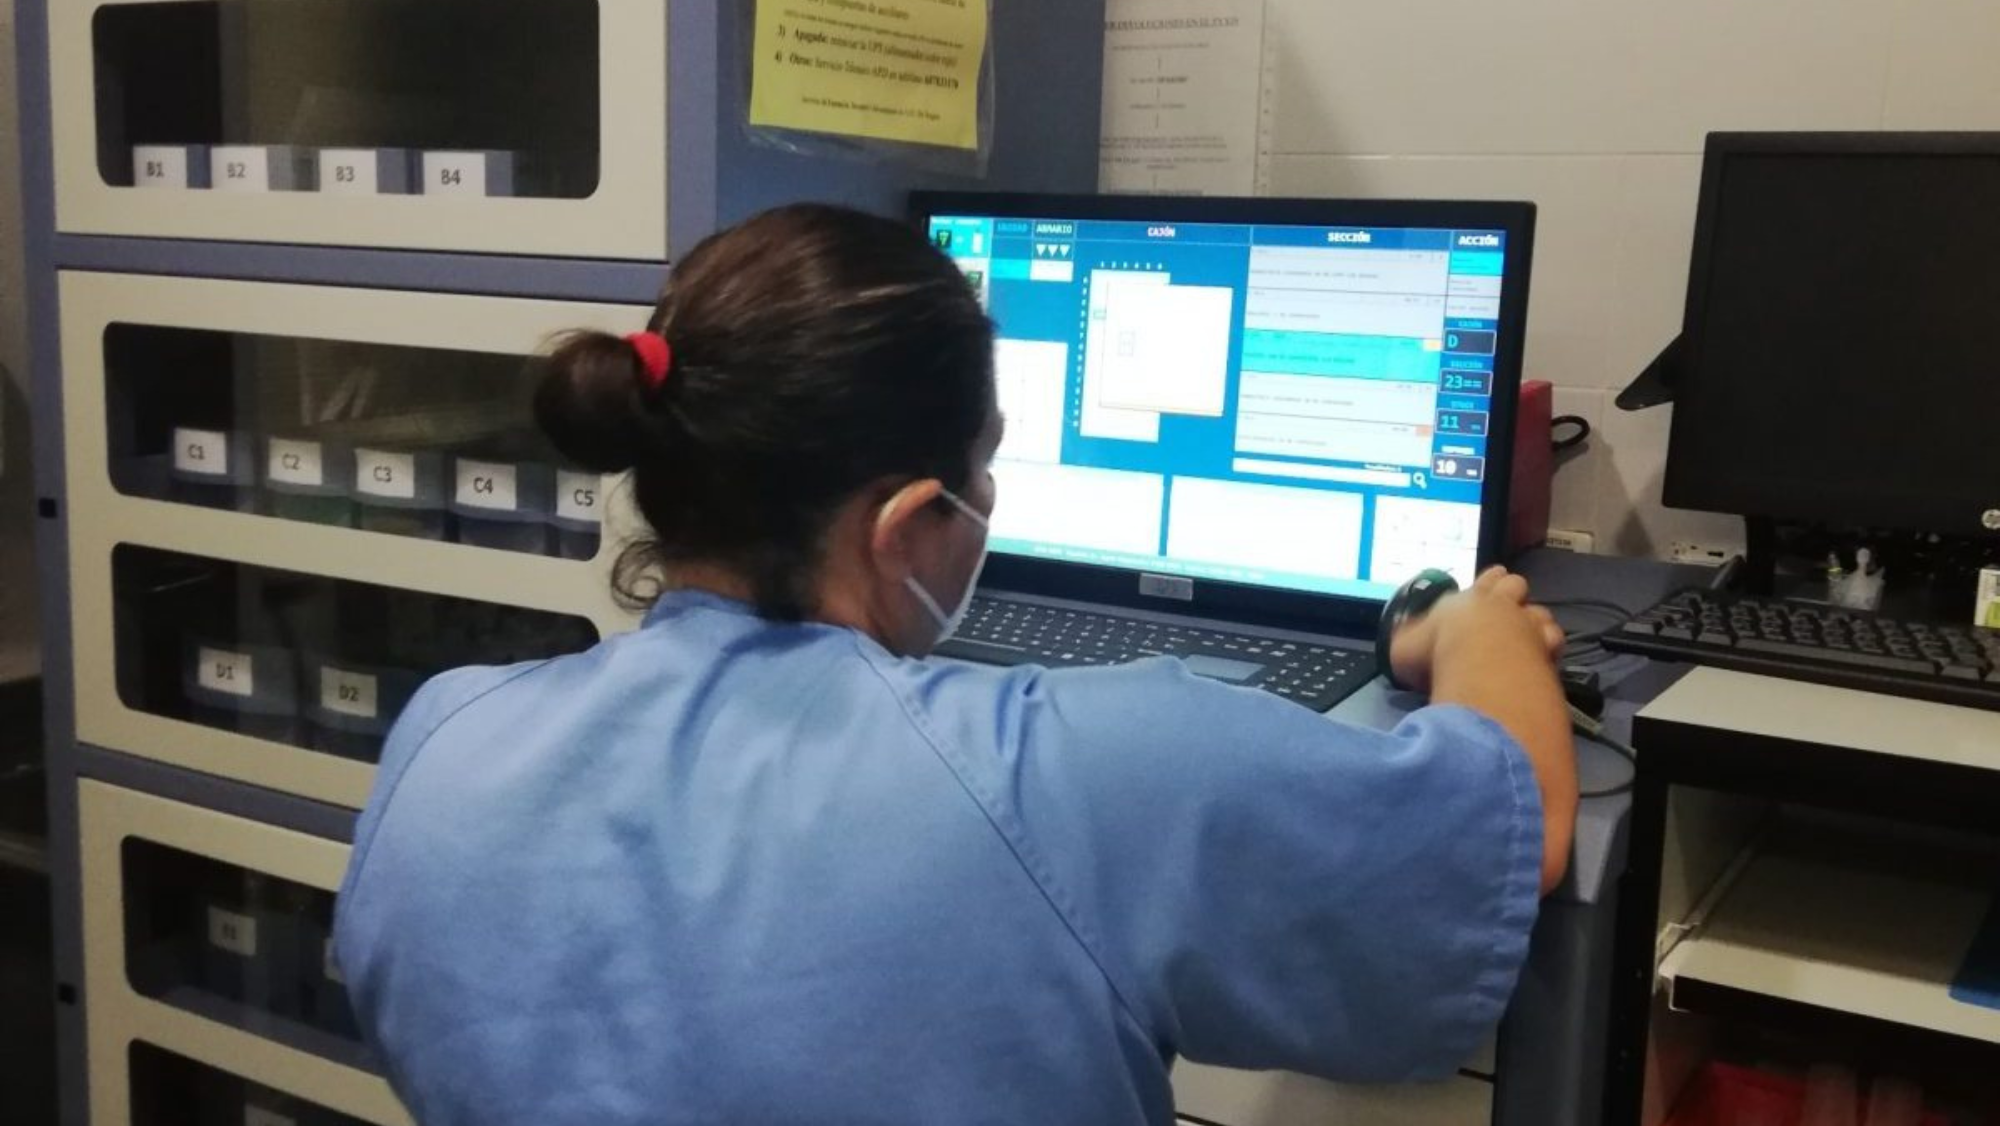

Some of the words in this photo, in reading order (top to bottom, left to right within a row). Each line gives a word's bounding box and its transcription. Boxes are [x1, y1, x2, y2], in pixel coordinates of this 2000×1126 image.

[147, 161, 164, 177] B1
[228, 162, 246, 178] B2
[336, 165, 354, 181] B3
[441, 169, 461, 185] B4
[1036, 224, 1073, 234] ARMARIO
[1148, 226, 1175, 237] CAJÓN
[1328, 231, 1371, 243] SECCIÓN
[1458, 234, 1499, 247] ACCIÓN
[1447, 334, 1458, 348] D
[1440, 415, 1459, 429] 11
[188, 443, 205, 460] C1
[282, 453, 300, 471] C2
[373, 465, 392, 483] C3
[473, 476, 494, 494] C4
[574, 489, 594, 507] C5
[216, 662, 234, 680] D1
[340, 685, 358, 701] D2
